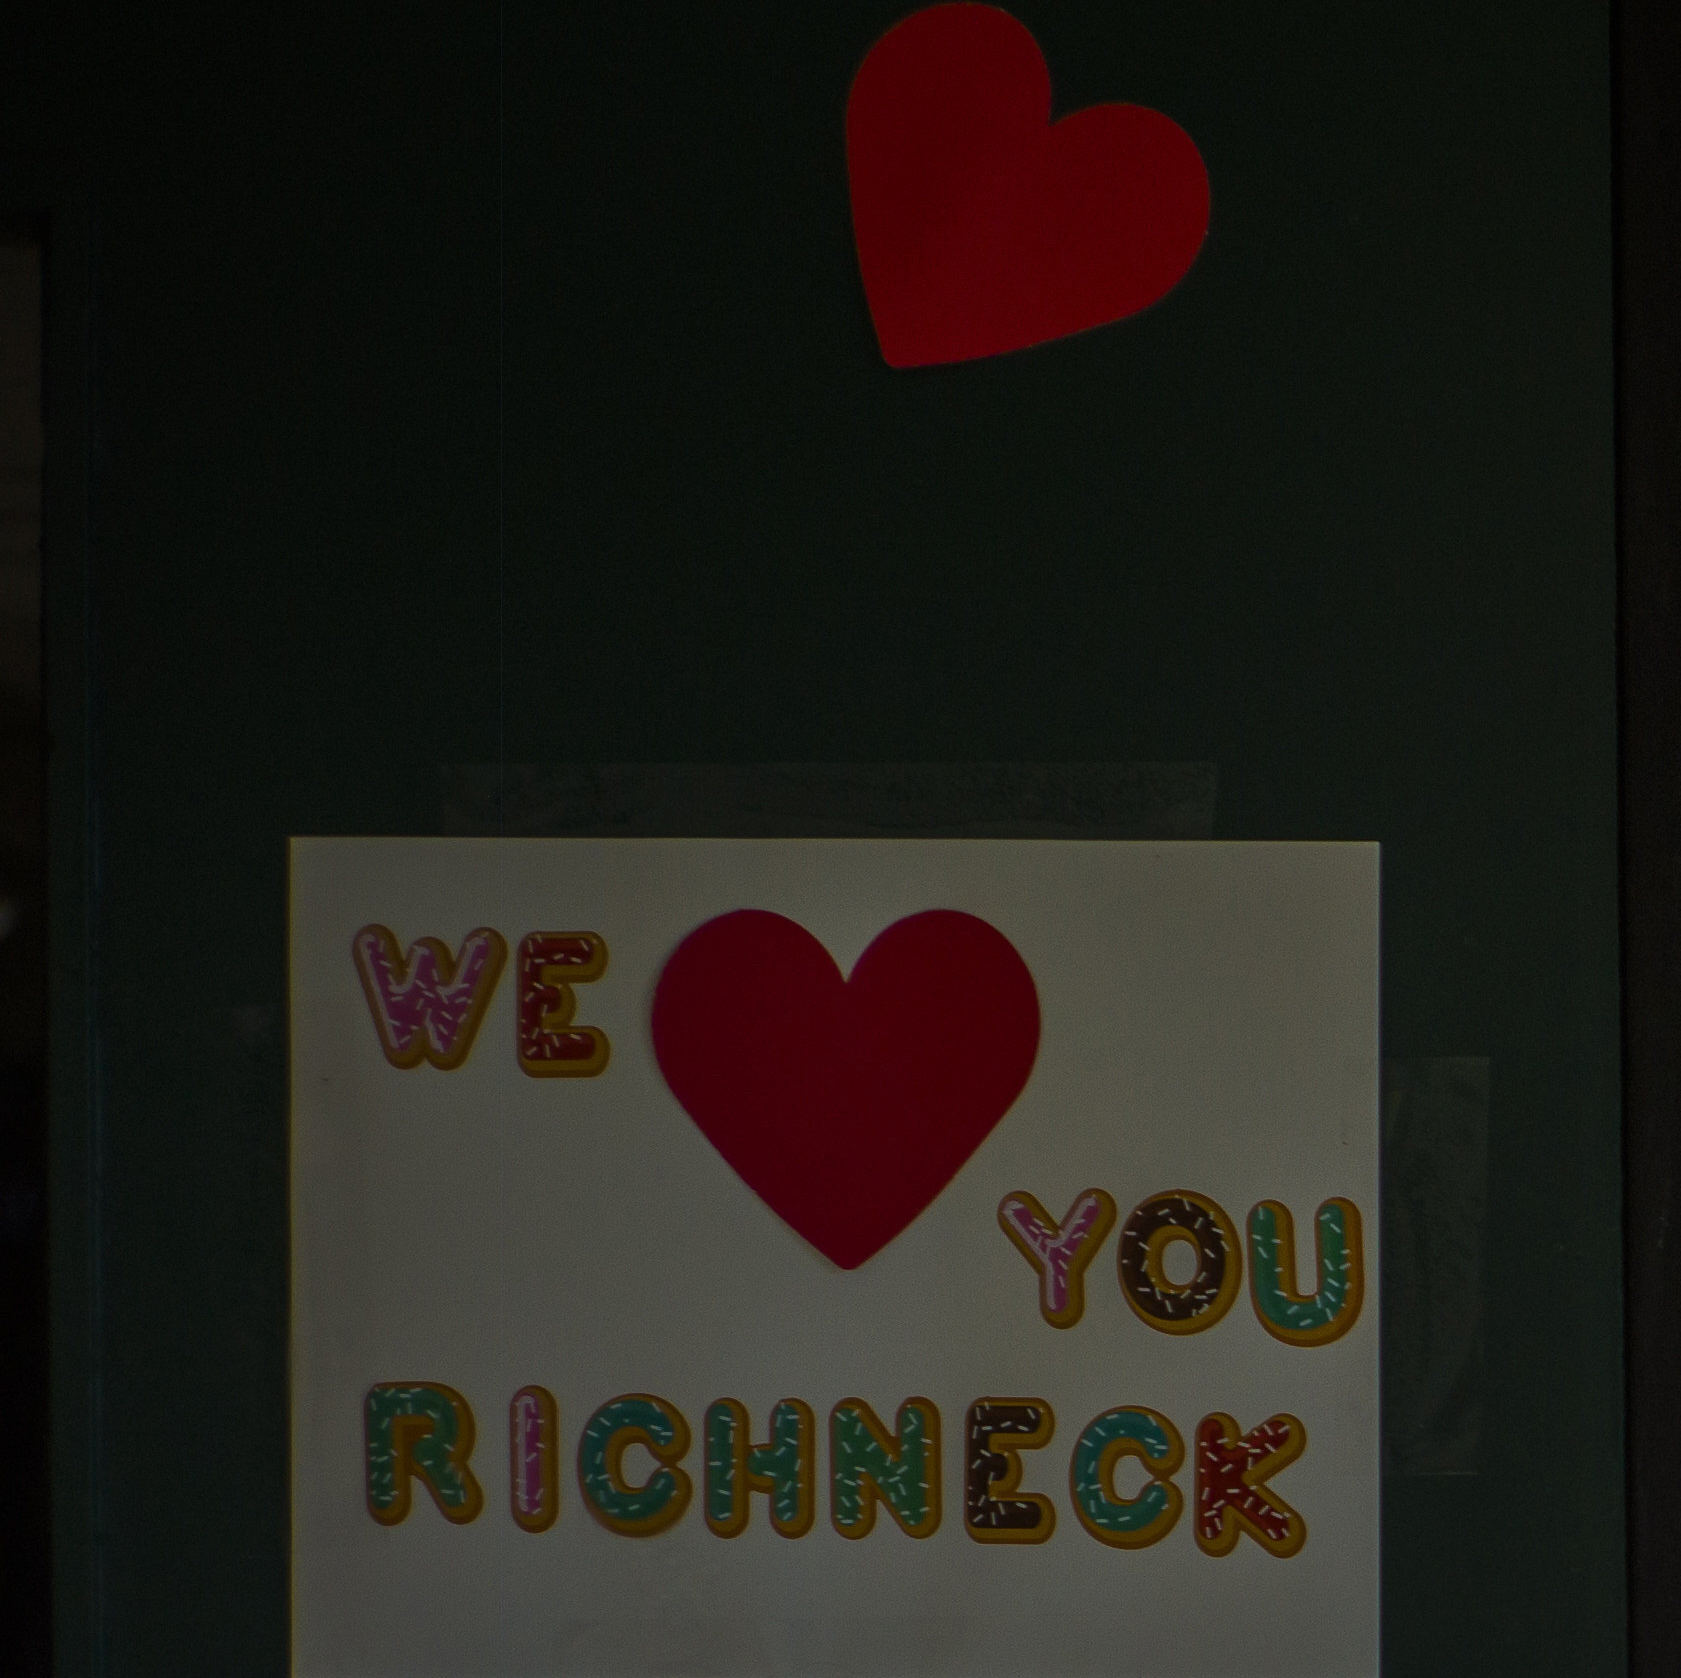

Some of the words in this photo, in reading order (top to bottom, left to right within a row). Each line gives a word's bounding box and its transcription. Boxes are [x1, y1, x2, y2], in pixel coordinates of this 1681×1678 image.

[351, 923, 610, 1078] WE
[996, 1188, 1364, 1348] YOU
[363, 1380, 1307, 1558] RICHNECK
